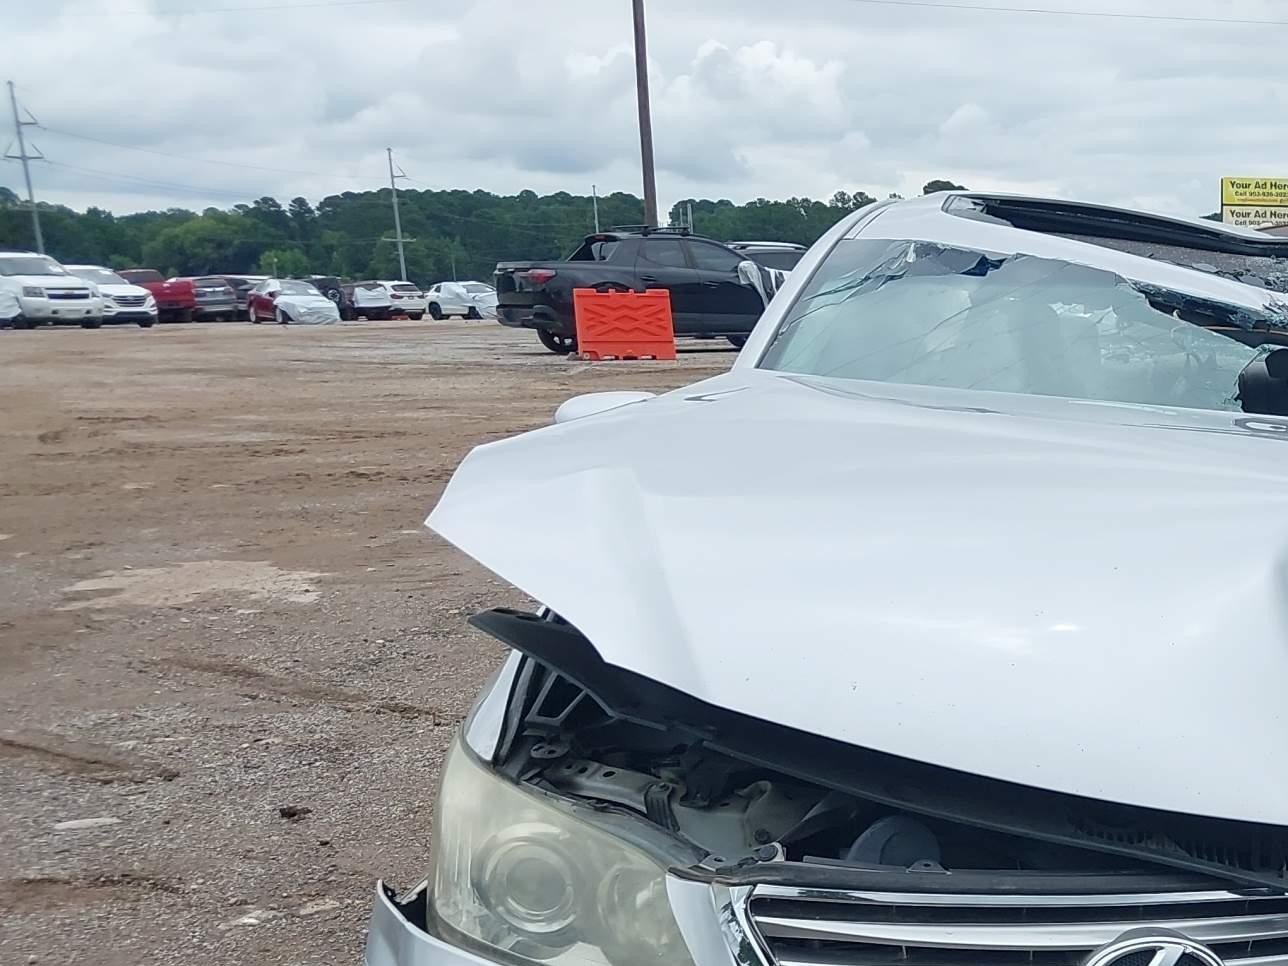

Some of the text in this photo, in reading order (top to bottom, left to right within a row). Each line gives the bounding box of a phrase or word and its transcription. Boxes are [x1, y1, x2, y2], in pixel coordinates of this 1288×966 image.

[1229, 180, 1252, 189] Your
[1254, 181, 1267, 190] Ad
[1229, 209, 1252, 218] Your
[1253, 210, 1267, 219] Ad
